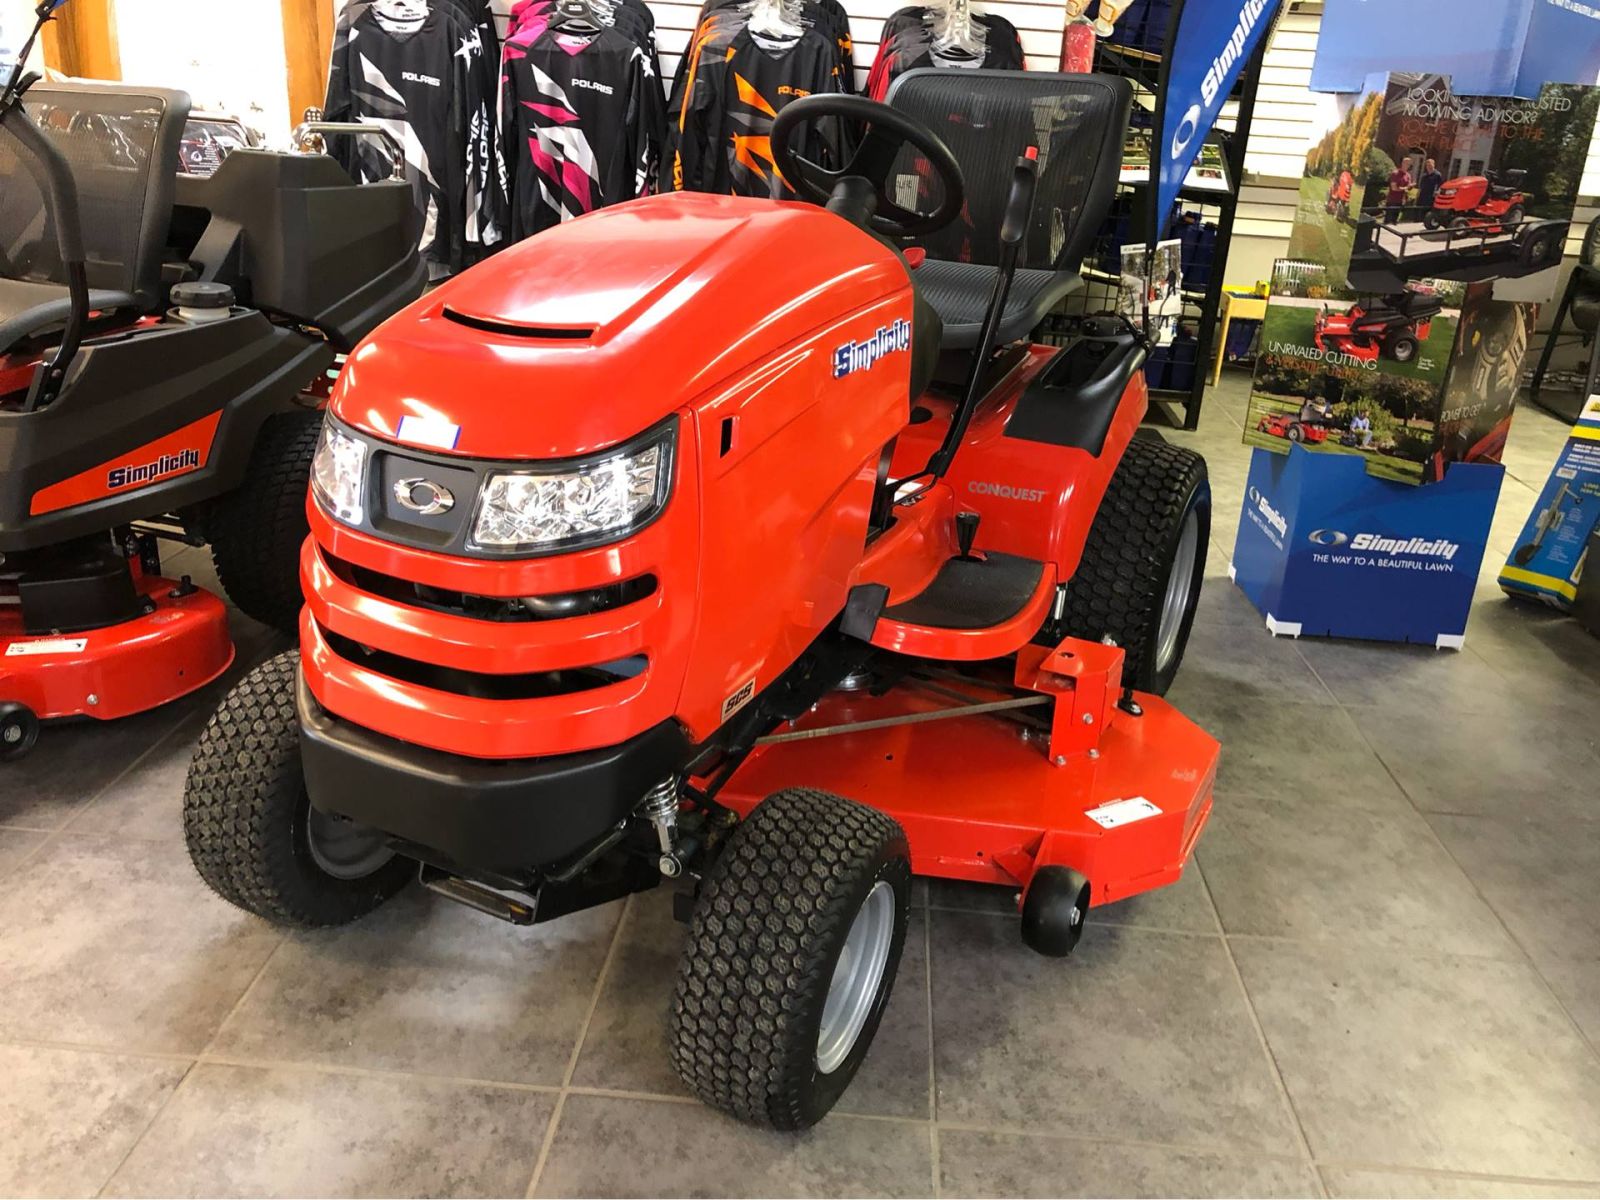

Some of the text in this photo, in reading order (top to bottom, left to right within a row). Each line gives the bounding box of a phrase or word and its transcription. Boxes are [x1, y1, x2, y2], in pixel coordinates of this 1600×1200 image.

[1201, 0, 1268, 107] Simplic
[402, 72, 440, 86] POLARIS
[571, 79, 613, 94] POLARIS
[1407, 88, 1468, 105] LOOKING
[1402, 103, 1538, 124] MOWING ADVISOR?
[834, 318, 911, 379] Simplicity
[1269, 341, 1378, 370] UNRIVALED CUTTING
[107, 448, 200, 490] Simplicity
[968, 481, 1045, 502] CONQUEST
[1350, 533, 1459, 560] Simplicity
[1313, 554, 1454, 572] THE WAY TO A BEAUTIFUL LAWN
